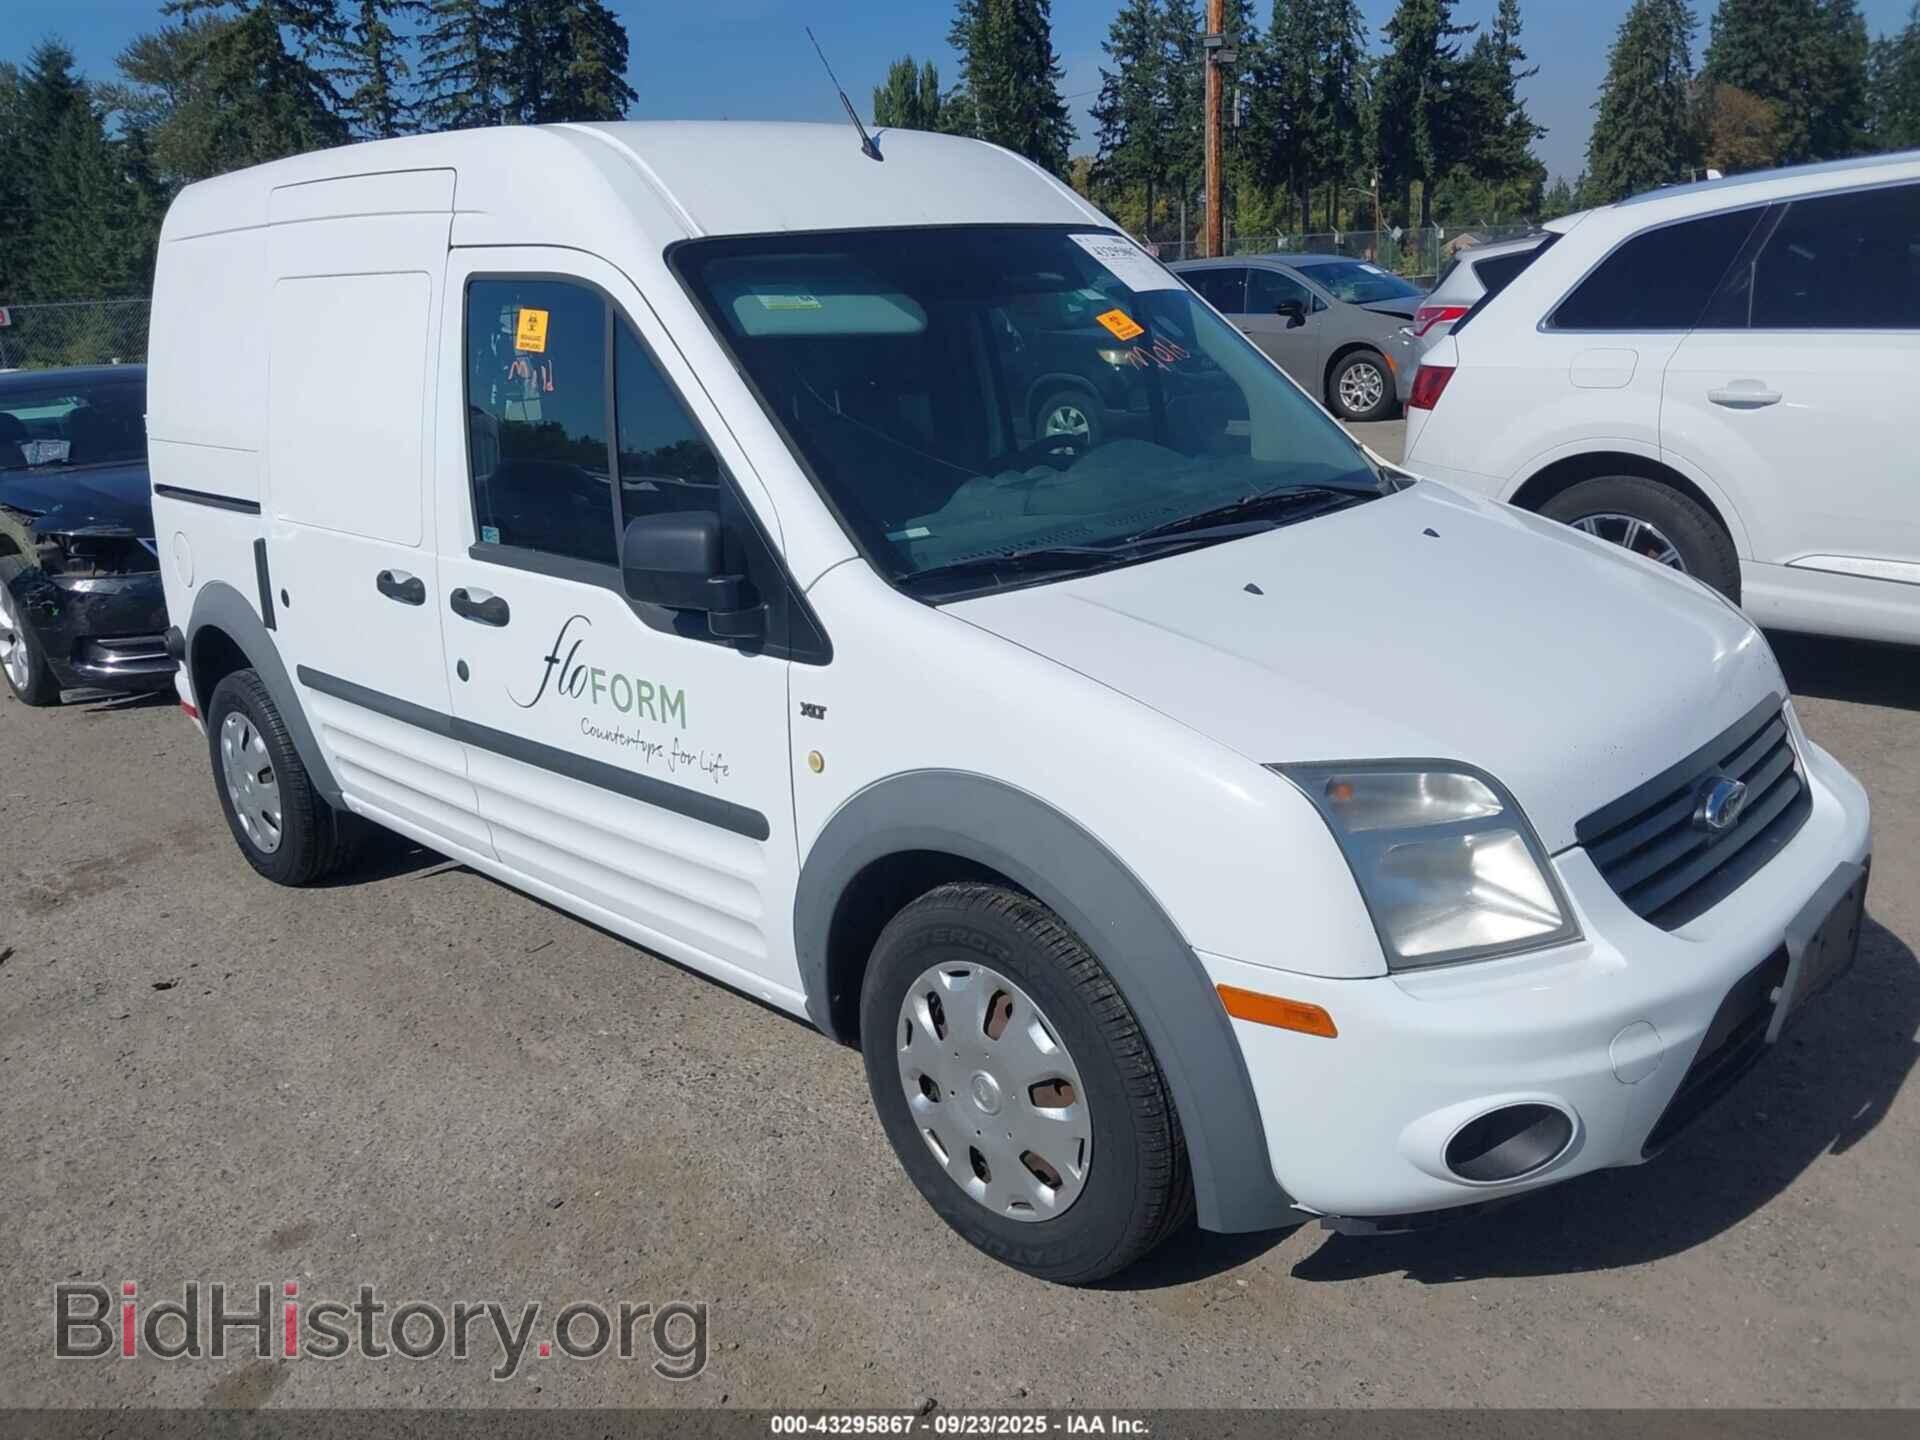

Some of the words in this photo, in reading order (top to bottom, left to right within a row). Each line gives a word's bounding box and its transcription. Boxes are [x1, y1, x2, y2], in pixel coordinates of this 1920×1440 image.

[505, 614, 687, 729] floFORM
[581, 716, 663, 764] Countertops
[667, 737, 696, 773] for
[699, 749, 730, 784] Life
